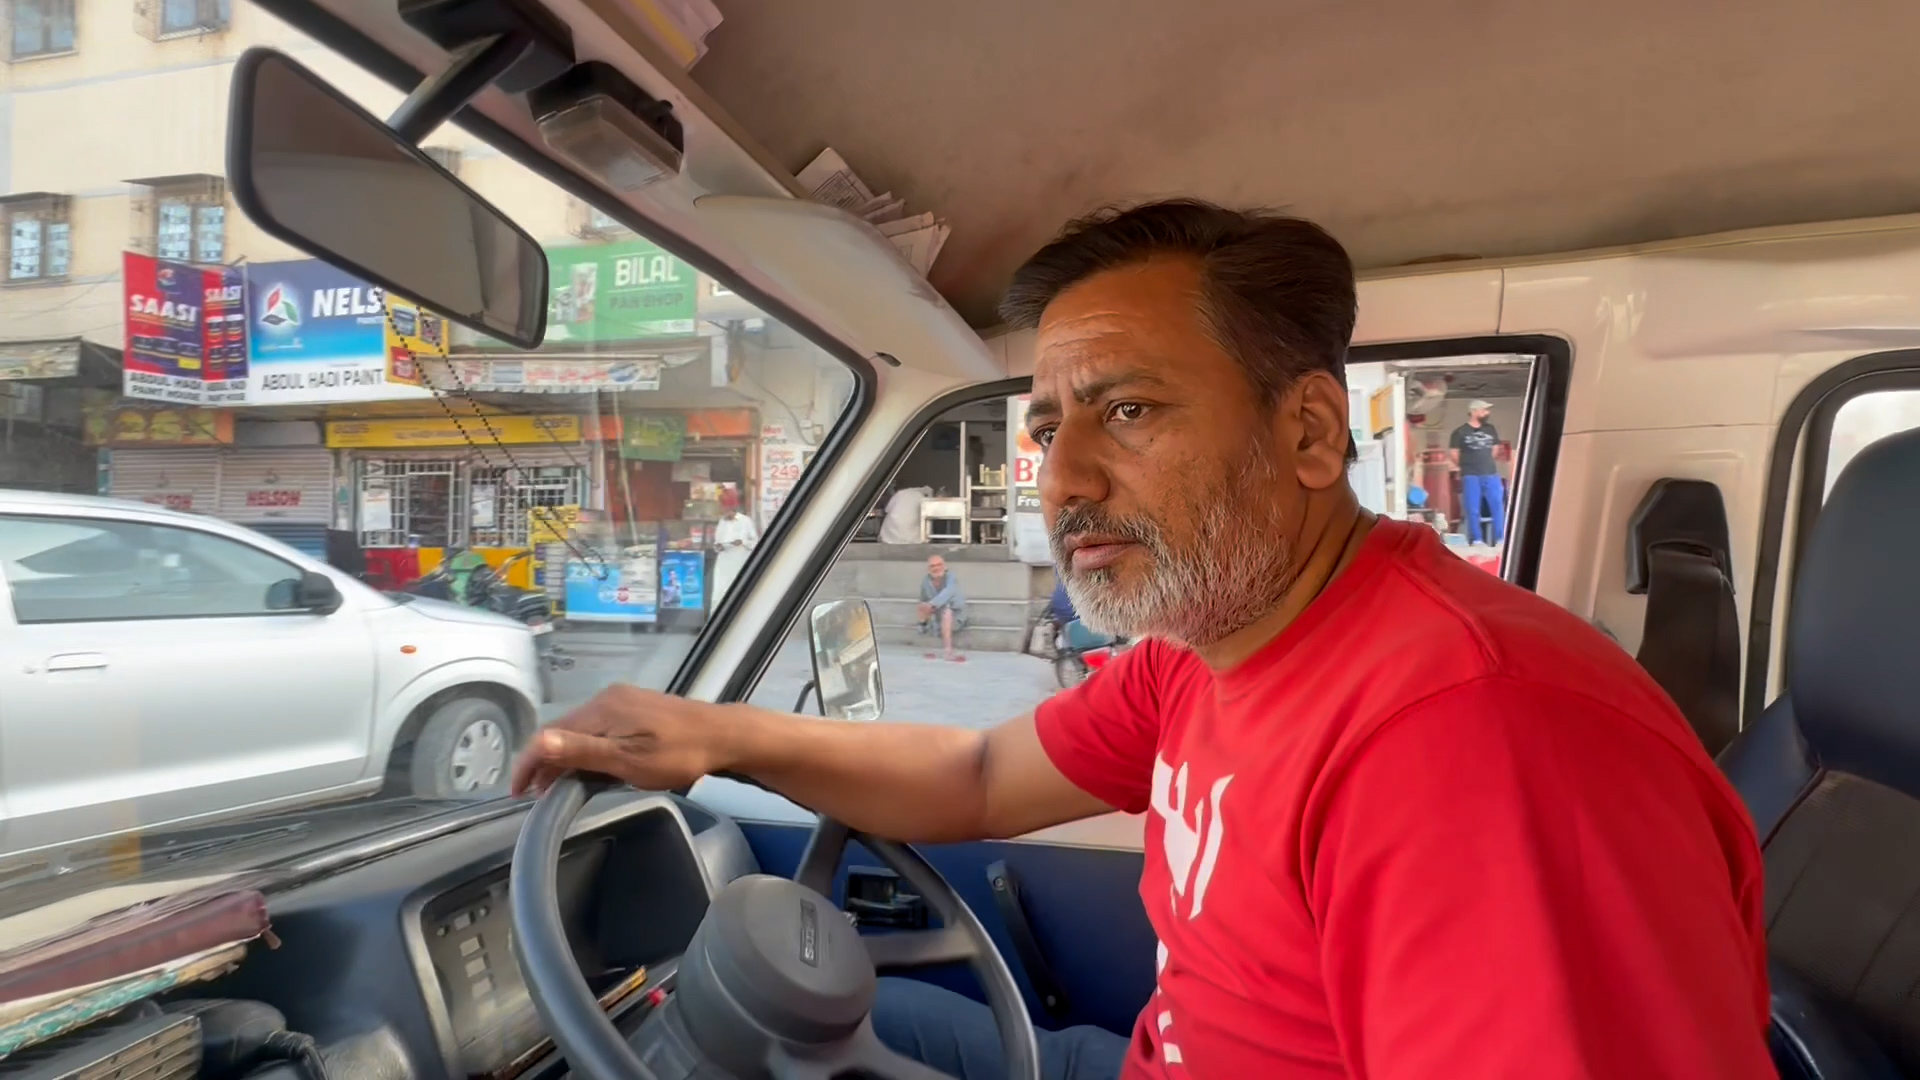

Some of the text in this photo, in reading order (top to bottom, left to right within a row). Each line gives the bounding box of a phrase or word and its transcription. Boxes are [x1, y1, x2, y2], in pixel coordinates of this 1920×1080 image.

[615, 256, 680, 286] BILAL
[129, 294, 198, 322] SAASI
[262, 368, 383, 390] ABDUL HADI PAINT
[771, 465, 799, 479] 249
[246, 490, 301, 506] NELSON
